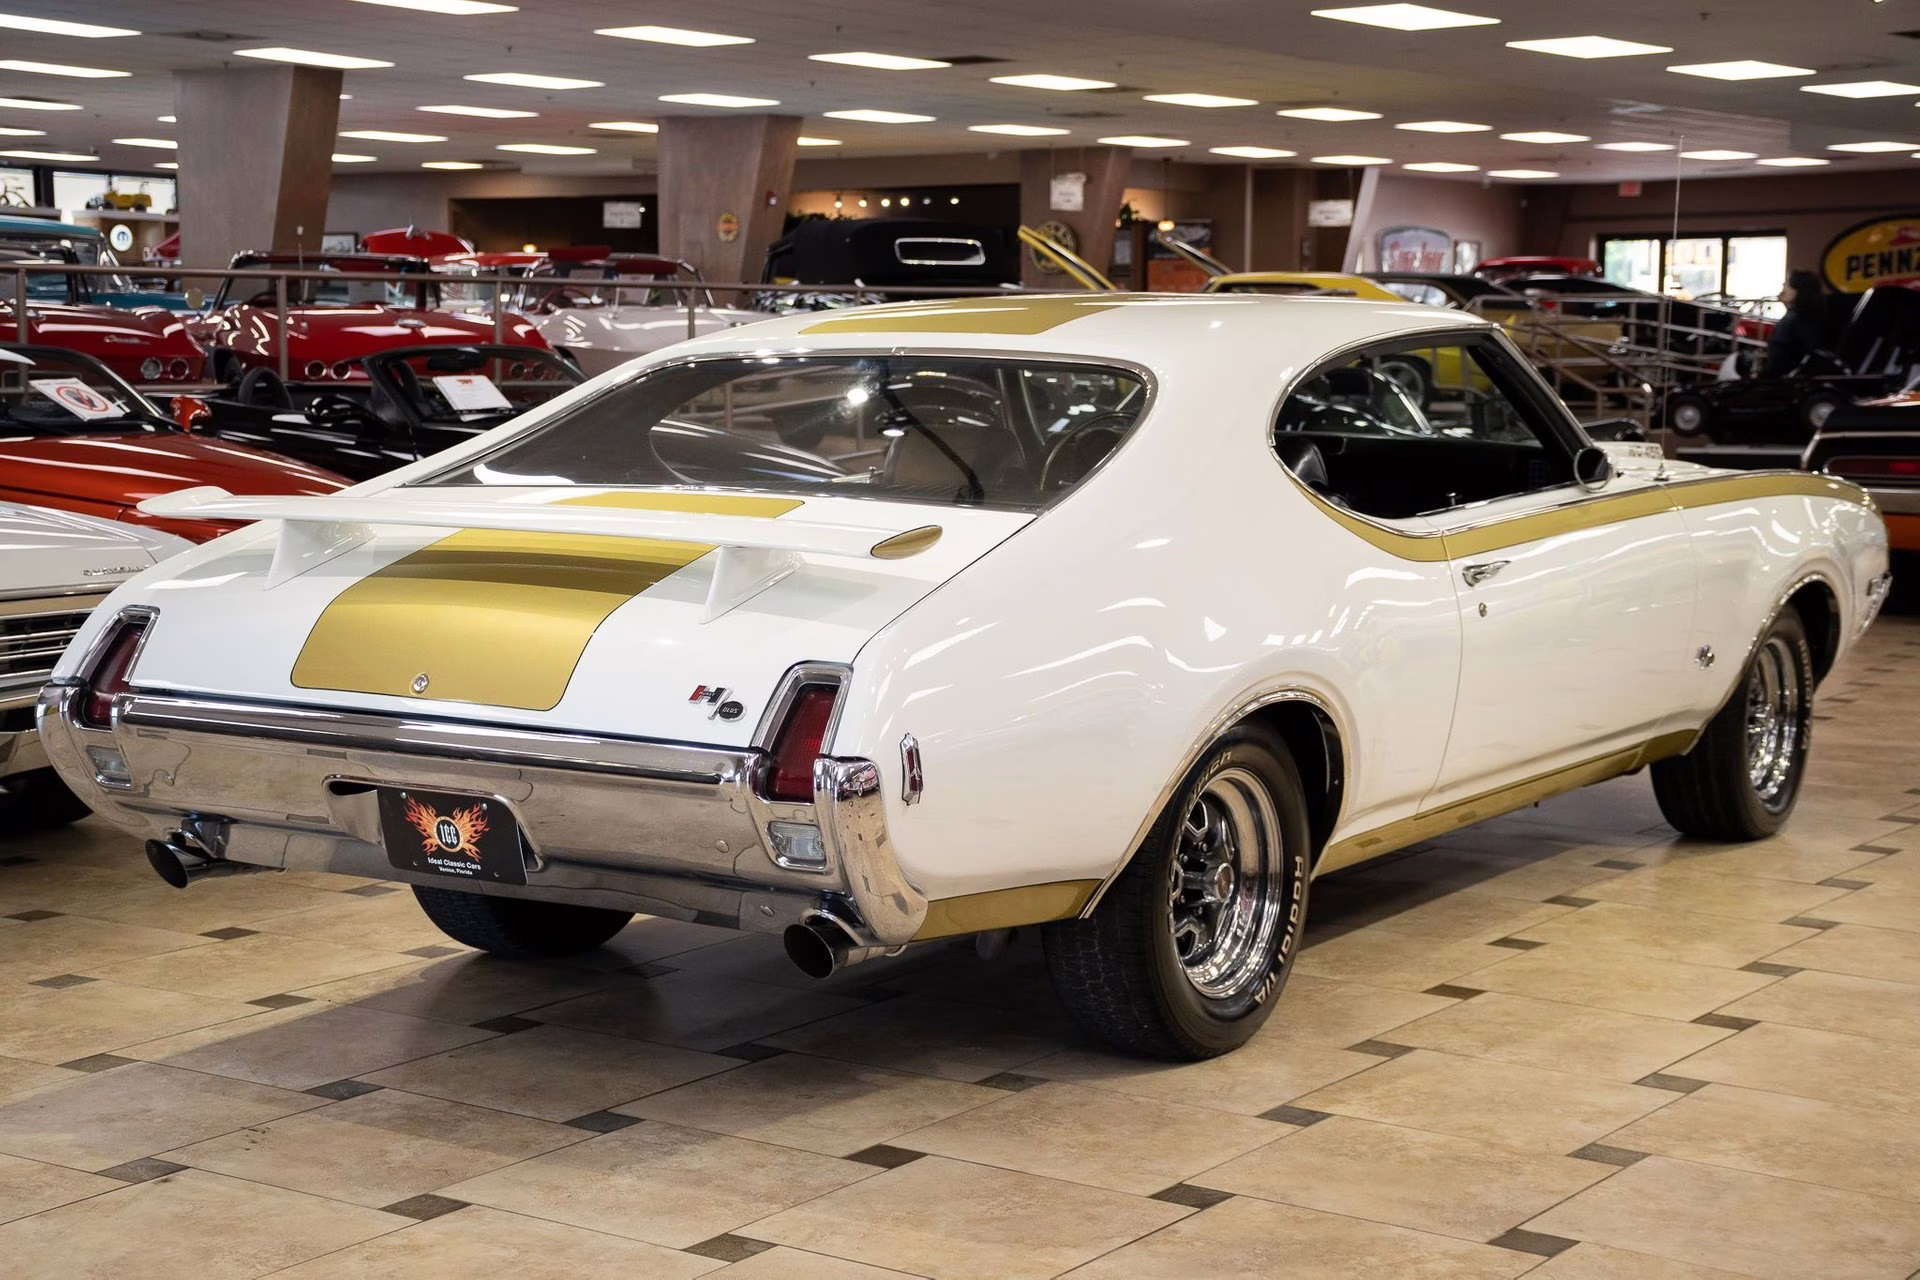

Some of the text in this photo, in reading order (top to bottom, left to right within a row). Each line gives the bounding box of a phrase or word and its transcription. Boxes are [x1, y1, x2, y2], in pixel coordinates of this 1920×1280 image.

[427, 857, 482, 870] Ideal Classic Cars
[456, 868, 473, 876] Florida
[1254, 855, 1304, 1005] Radial T/A
